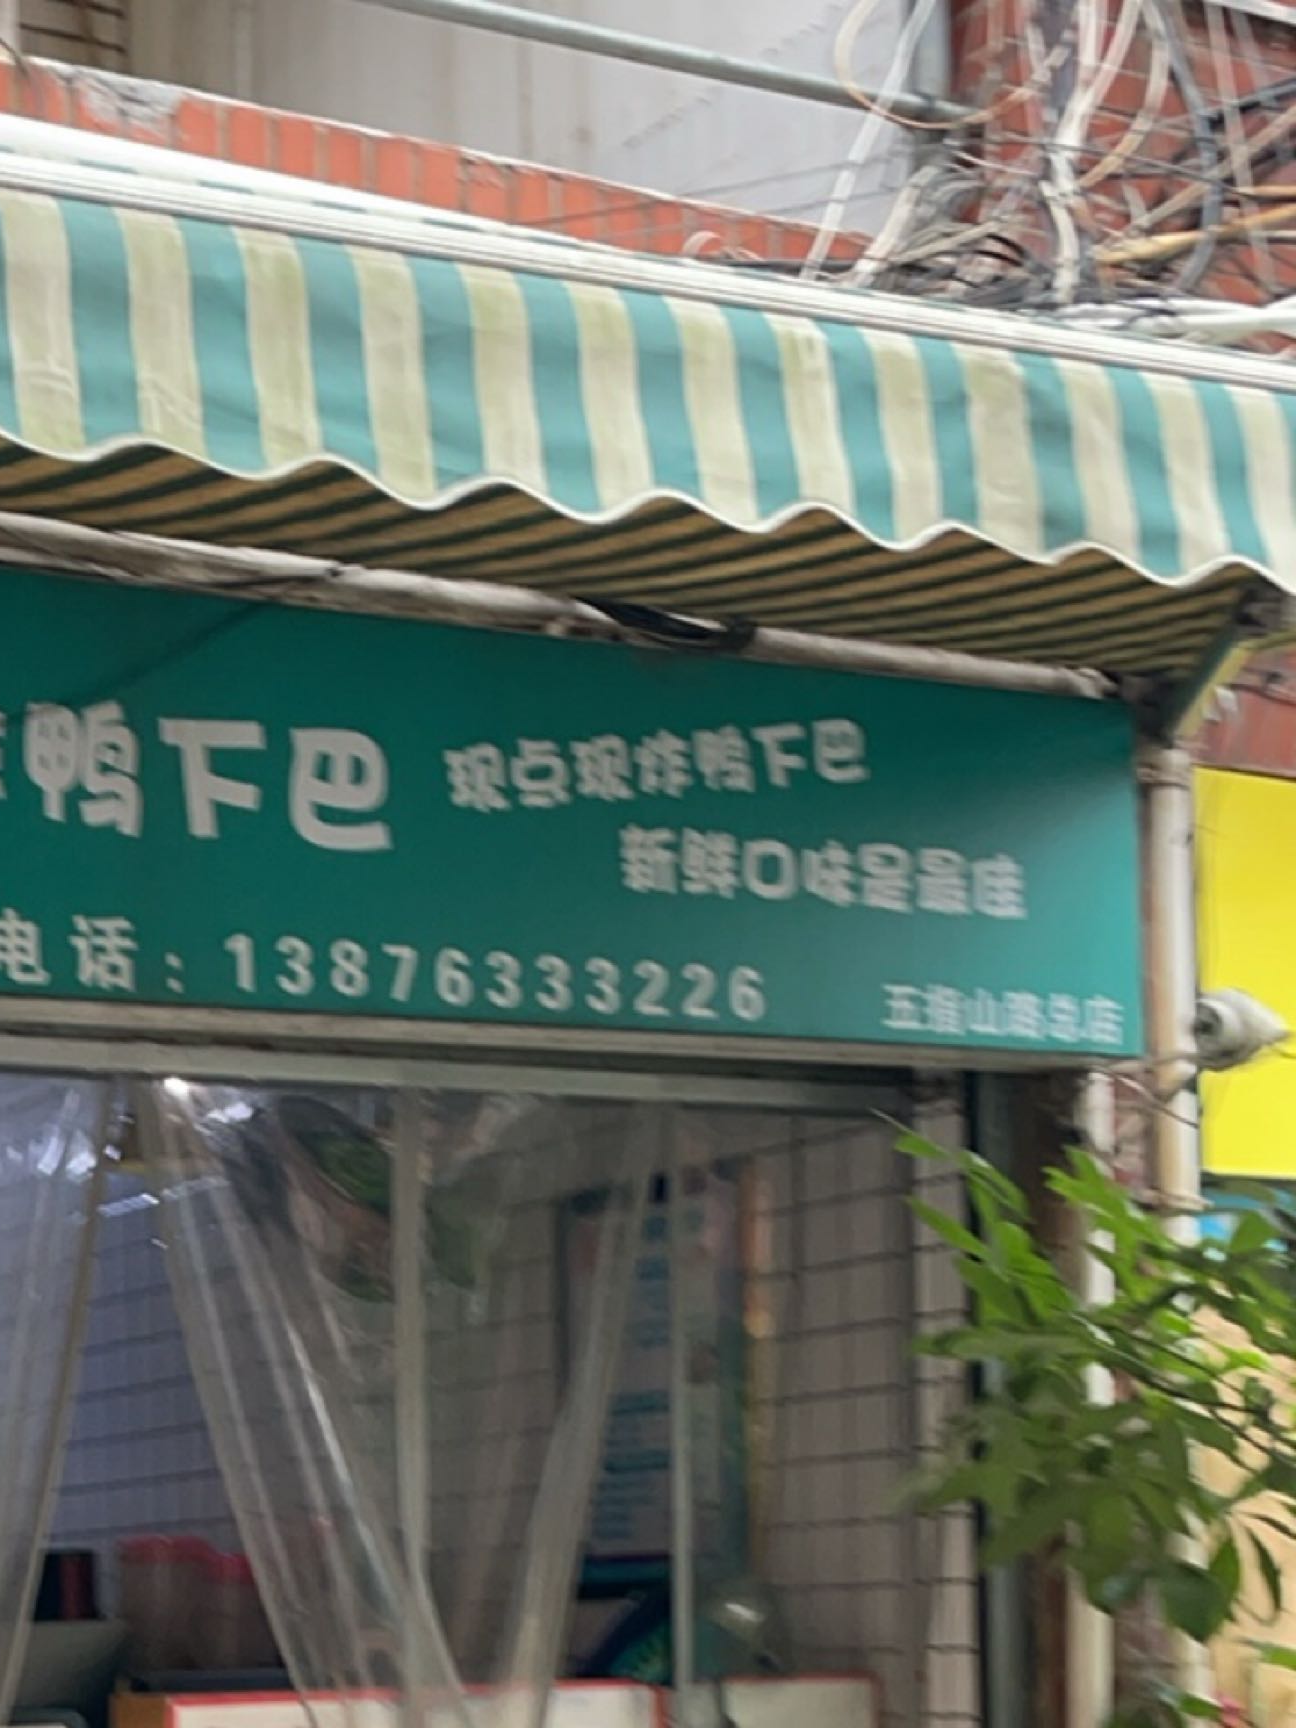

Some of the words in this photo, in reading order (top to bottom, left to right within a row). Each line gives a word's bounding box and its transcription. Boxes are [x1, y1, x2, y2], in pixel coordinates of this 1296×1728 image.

[443, 718, 870, 813] 现点现炸鸭下巴
